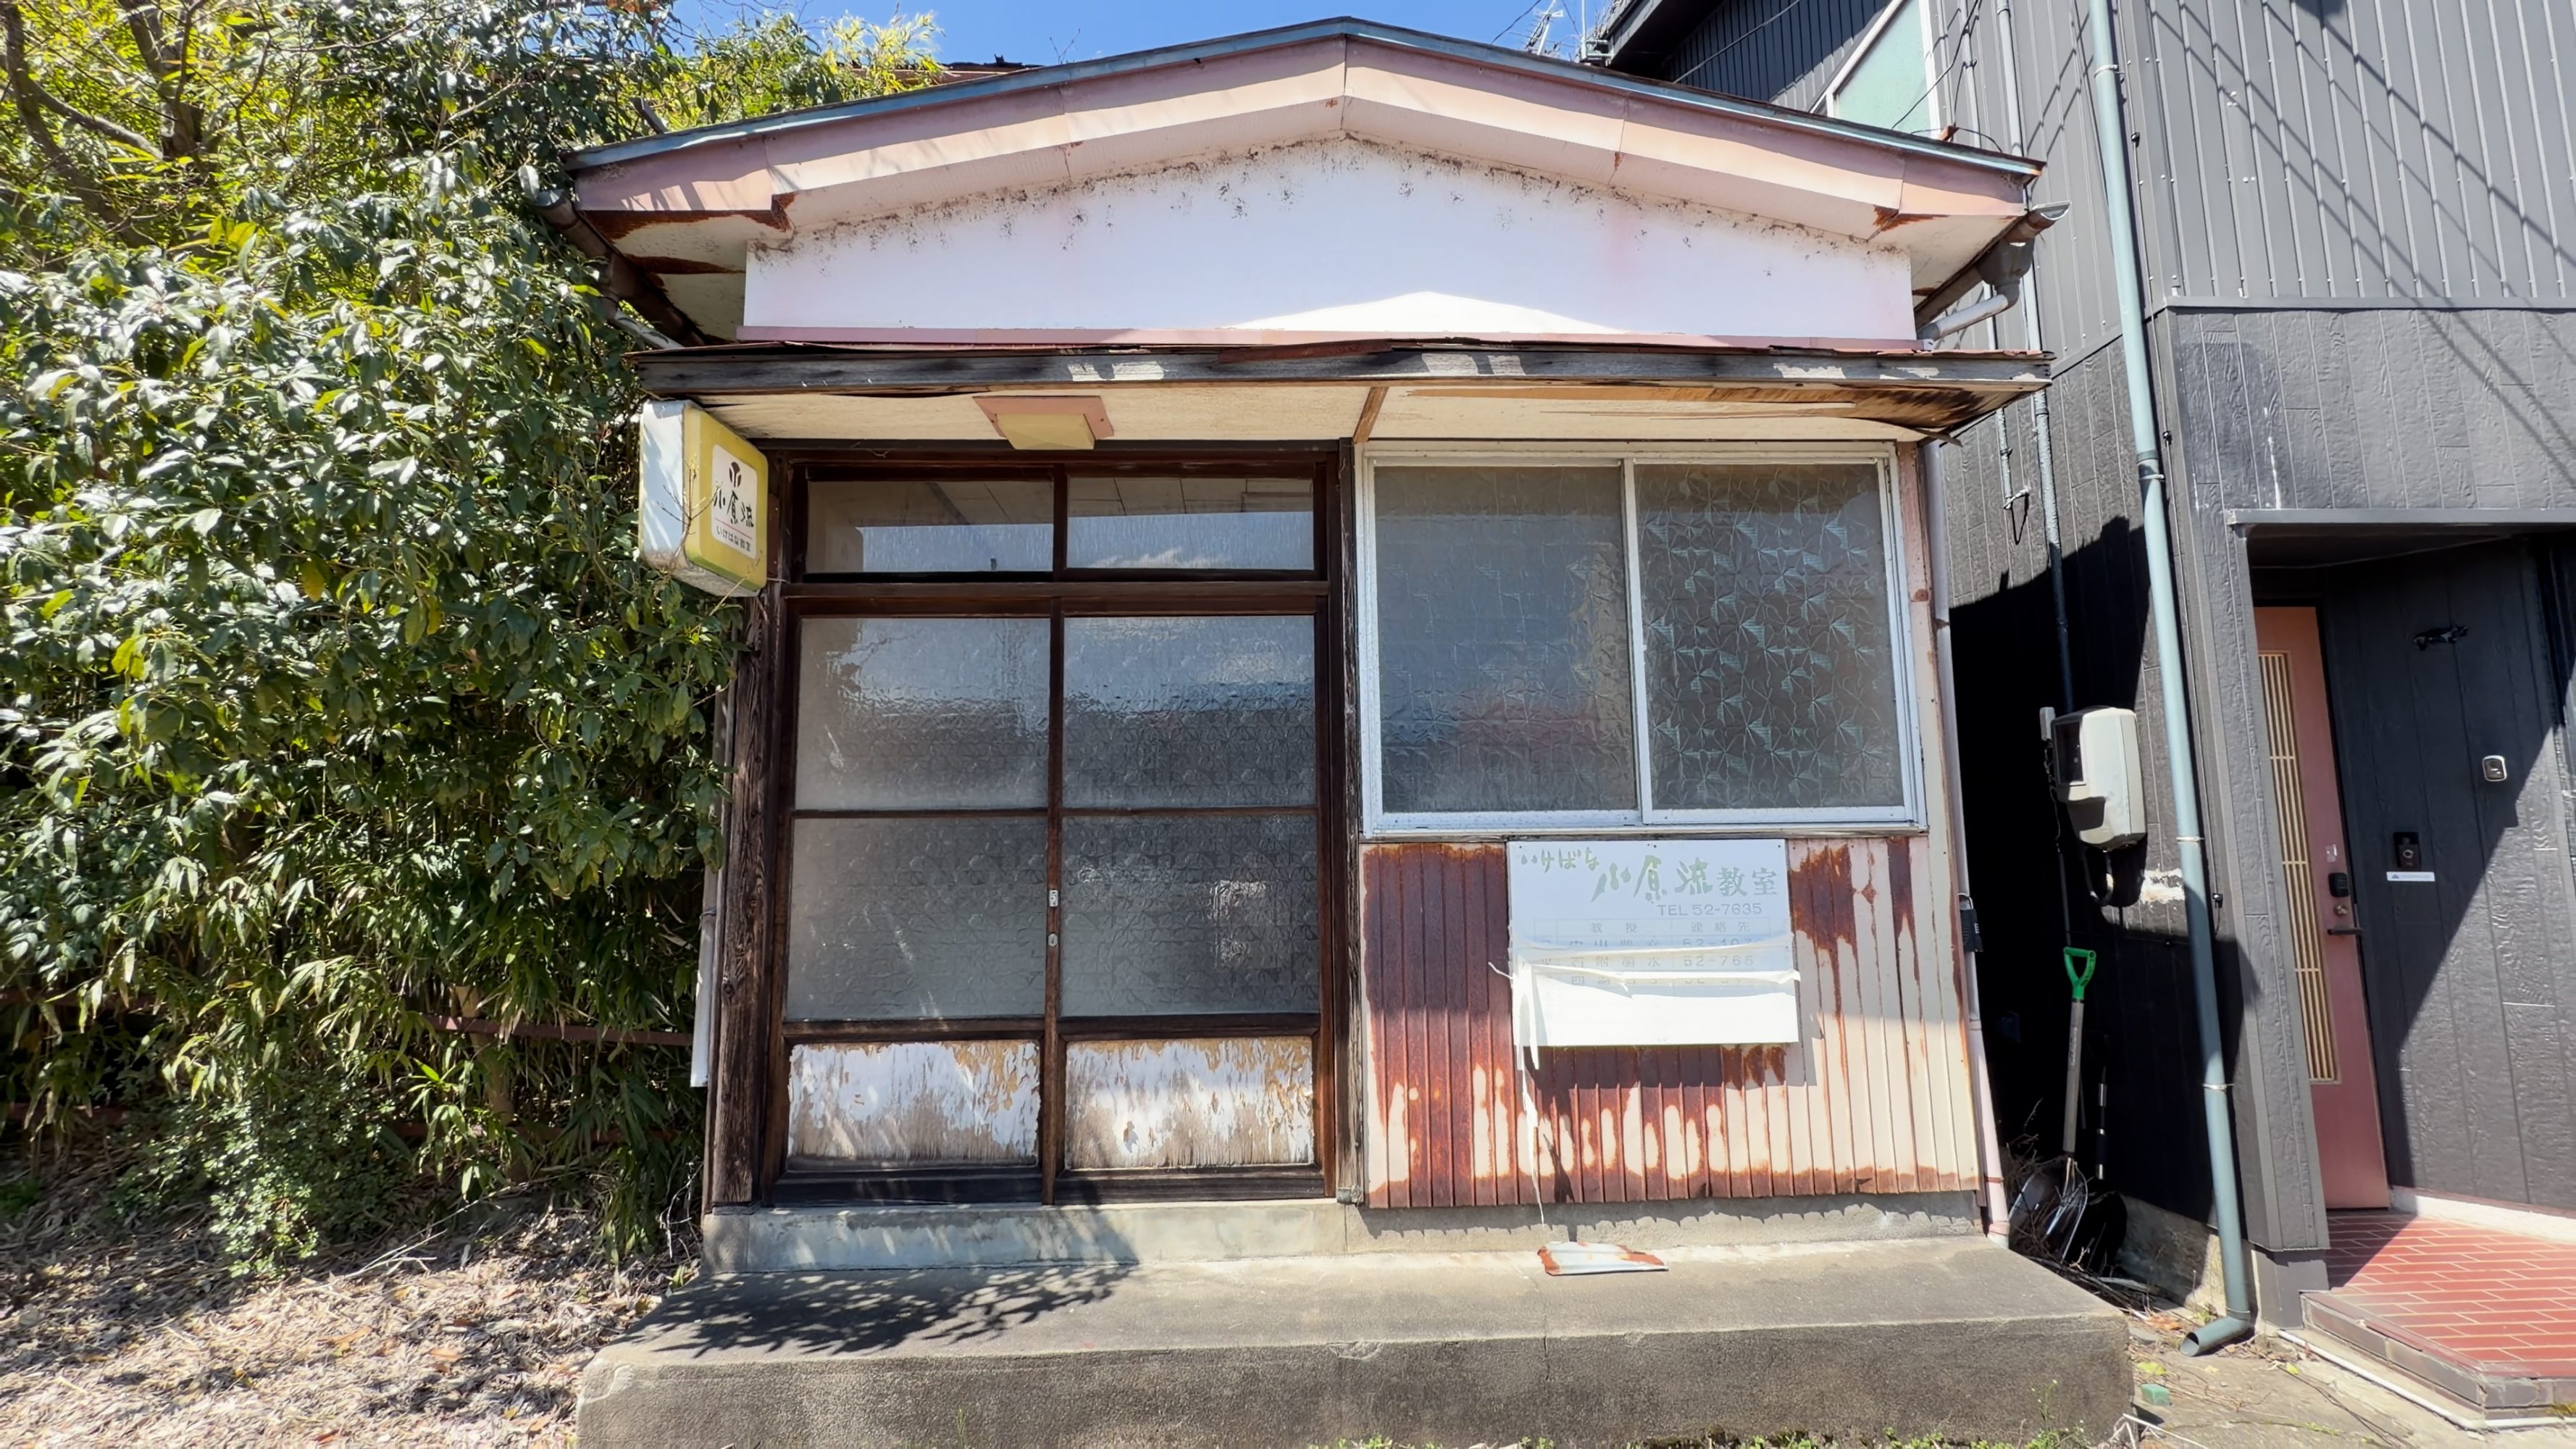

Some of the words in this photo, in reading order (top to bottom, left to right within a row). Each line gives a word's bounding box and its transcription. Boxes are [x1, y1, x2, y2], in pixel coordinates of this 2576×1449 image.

[714, 488, 754, 527] 小原流
[1657, 904, 1688, 916] TEL
[1692, 902, 1762, 916] 52-7635
